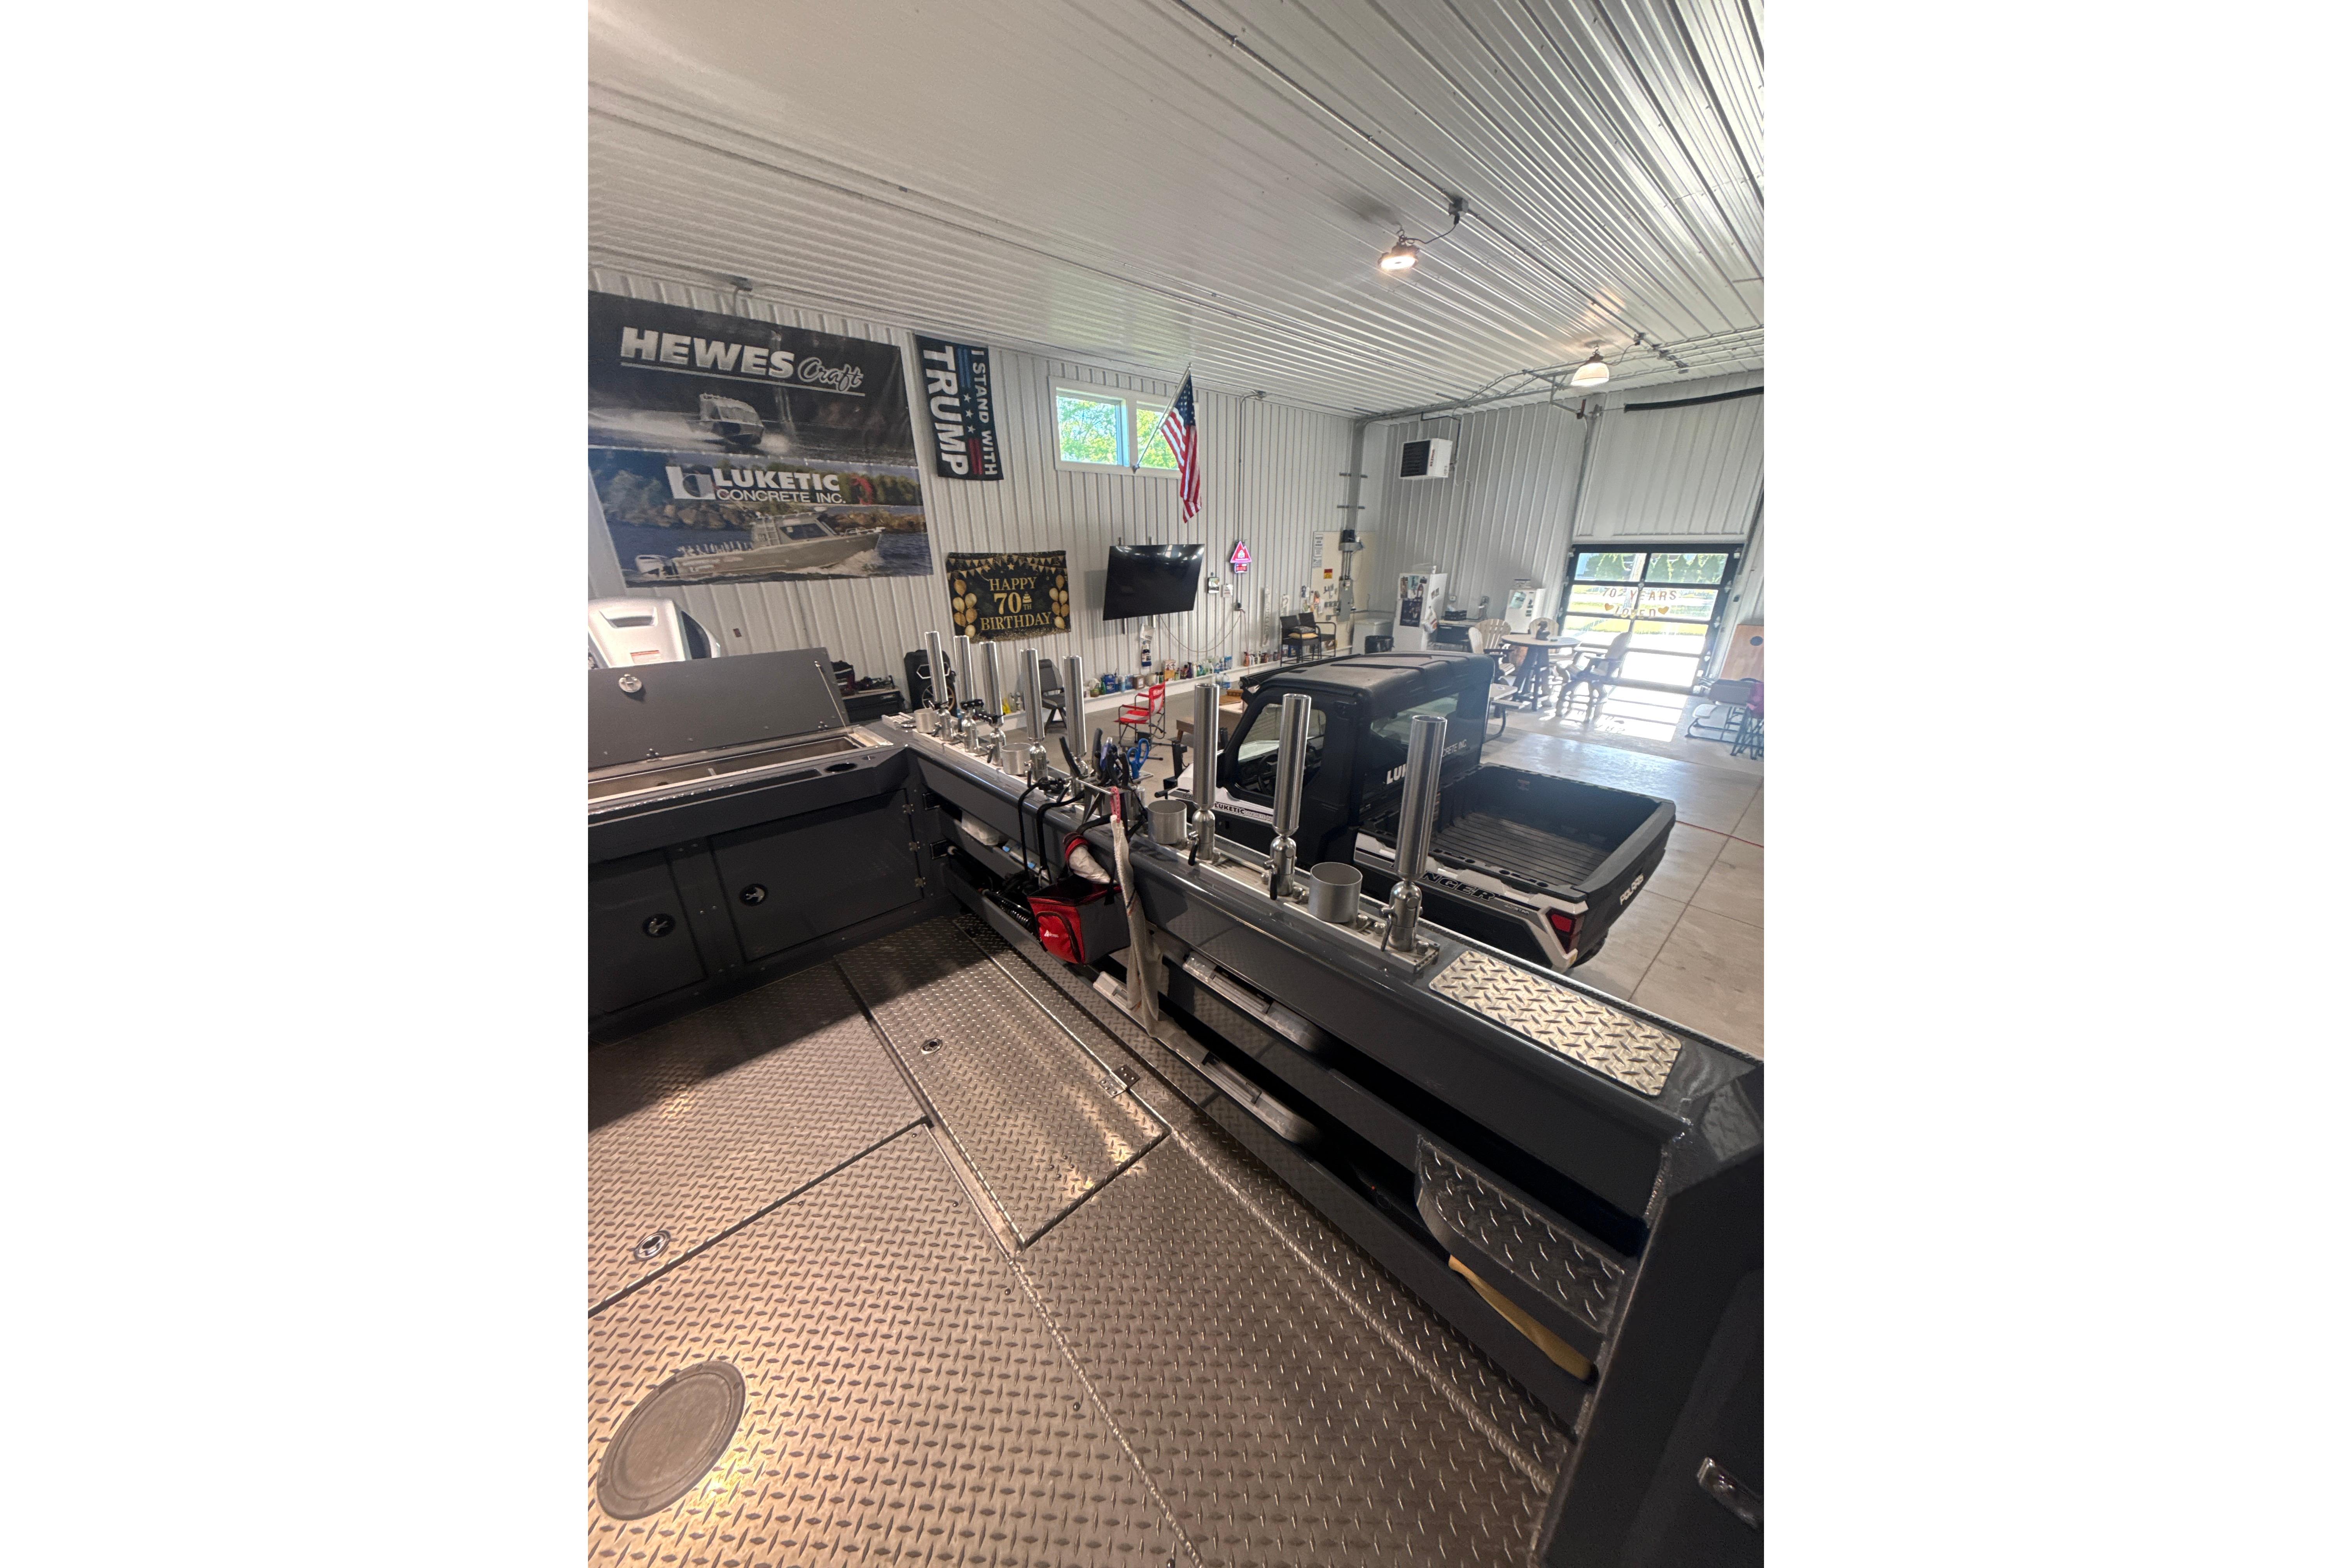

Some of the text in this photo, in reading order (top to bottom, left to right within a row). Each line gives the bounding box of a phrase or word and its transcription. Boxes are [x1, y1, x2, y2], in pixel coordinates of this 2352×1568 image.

[620, 326, 864, 392] HEWES Craft
[924, 346, 969, 475] TRUMP
[973, 363, 989, 423] STAND
[982, 430, 998, 475] WITH
[712, 468, 839, 491] LUKETIC
[716, 489, 846, 504] CONCRETE INC.
[990, 577, 1037, 591] HAPPY
[1602, 588, 1677, 601] 70 YEARS
[981, 612, 1051, 630] BIRTHDAY
[1442, 743, 1458, 757] CRETE
[1214, 803, 1244, 814] LUKETIC
[1422, 871, 1495, 901] NGER
[1620, 873, 1644, 905] POLARIS
